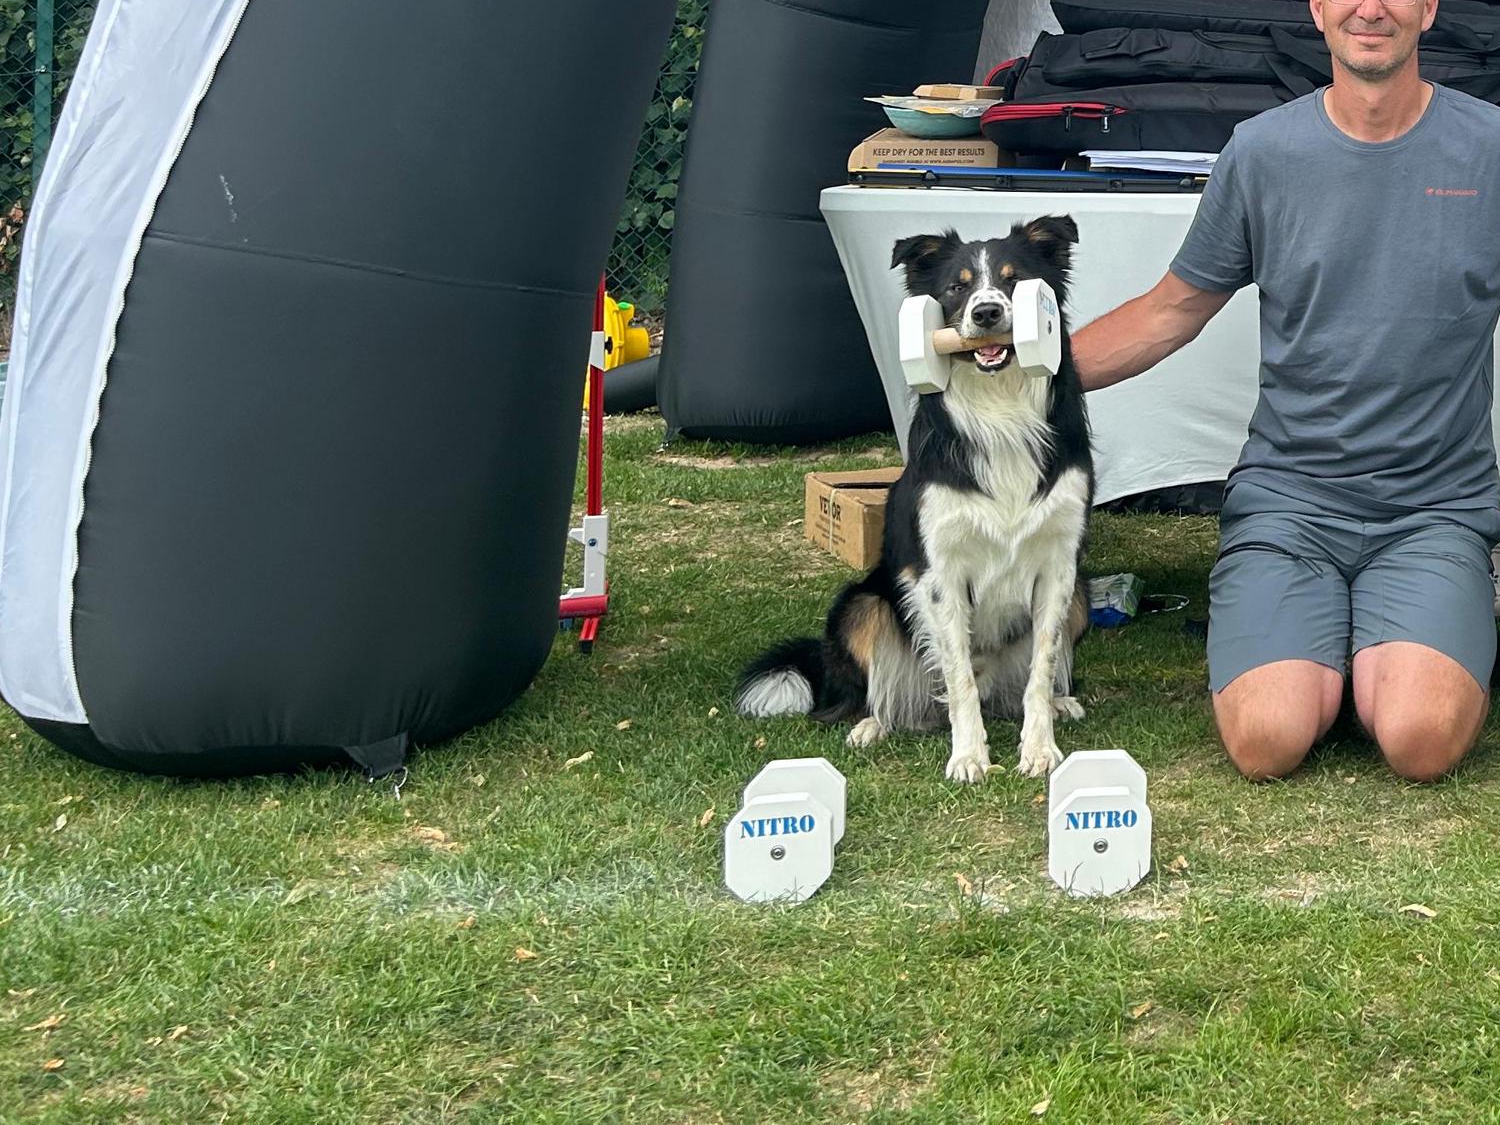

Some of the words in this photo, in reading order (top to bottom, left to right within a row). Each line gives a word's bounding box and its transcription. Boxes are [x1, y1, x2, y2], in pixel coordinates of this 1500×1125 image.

[873, 148, 890, 156] KEEP
[892, 148, 907, 156] DRY
[908, 148, 924, 156] FOR
[925, 148, 938, 156] THE
[939, 148, 956, 156] BEST
[957, 148, 985, 156] RESULTS
[819, 495, 842, 521] VEOR
[741, 814, 815, 839] NITRO
[1065, 810, 1138, 830] NITRO
